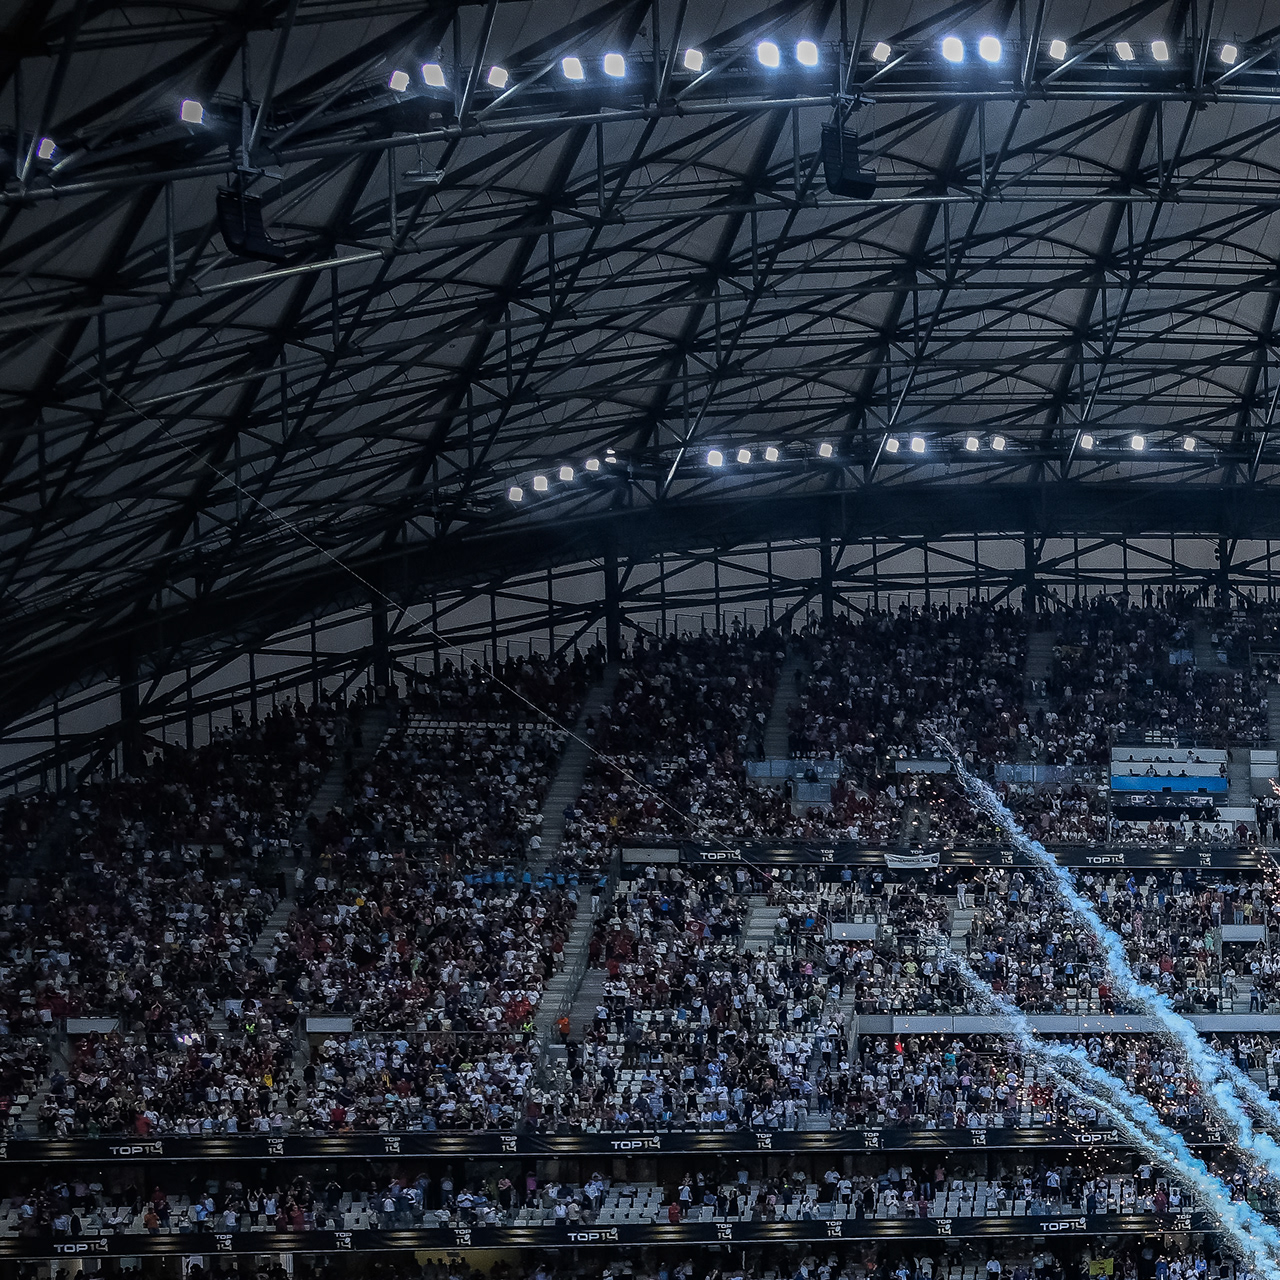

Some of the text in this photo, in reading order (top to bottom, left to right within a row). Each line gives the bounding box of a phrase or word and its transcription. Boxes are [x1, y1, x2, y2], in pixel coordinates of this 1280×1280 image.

[1086, 855, 1124, 865] TOP14
[611, 1138, 661, 1149] TOP14
[109, 1144, 163, 1155] TOP14
[1040, 1219, 1087, 1231] TOP14
[567, 1230, 618, 1242] TOP14
[53, 1241, 108, 1253] TOP14
